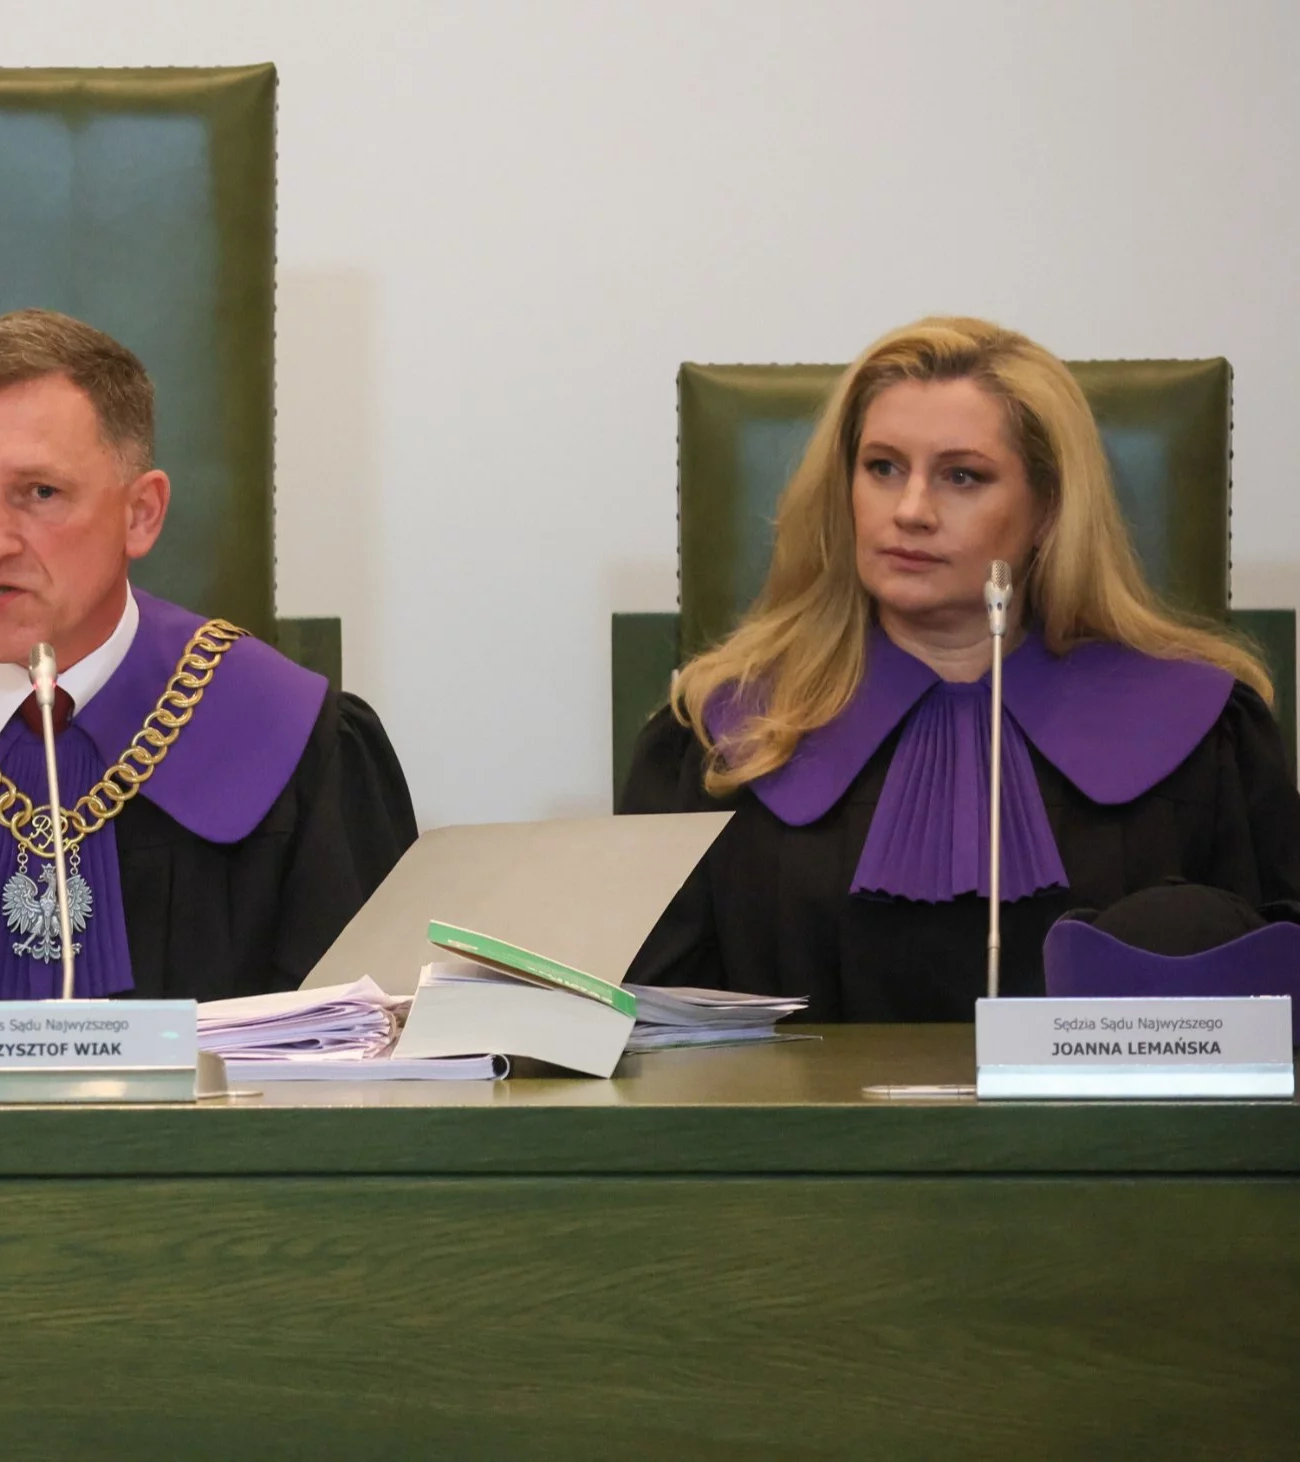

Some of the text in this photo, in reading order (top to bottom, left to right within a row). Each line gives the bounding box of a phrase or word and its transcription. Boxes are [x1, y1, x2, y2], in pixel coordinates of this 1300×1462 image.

[9, 1018, 42, 1033] Sądu
[45, 1018, 129, 1033] Najwyższego
[1053, 1017, 1223, 1033] Sędzia Sądu Najwyższego
[73, 1042, 122, 1056] WIAK
[1052, 1037, 1222, 1056] JOANNA LEMAŃSKA
